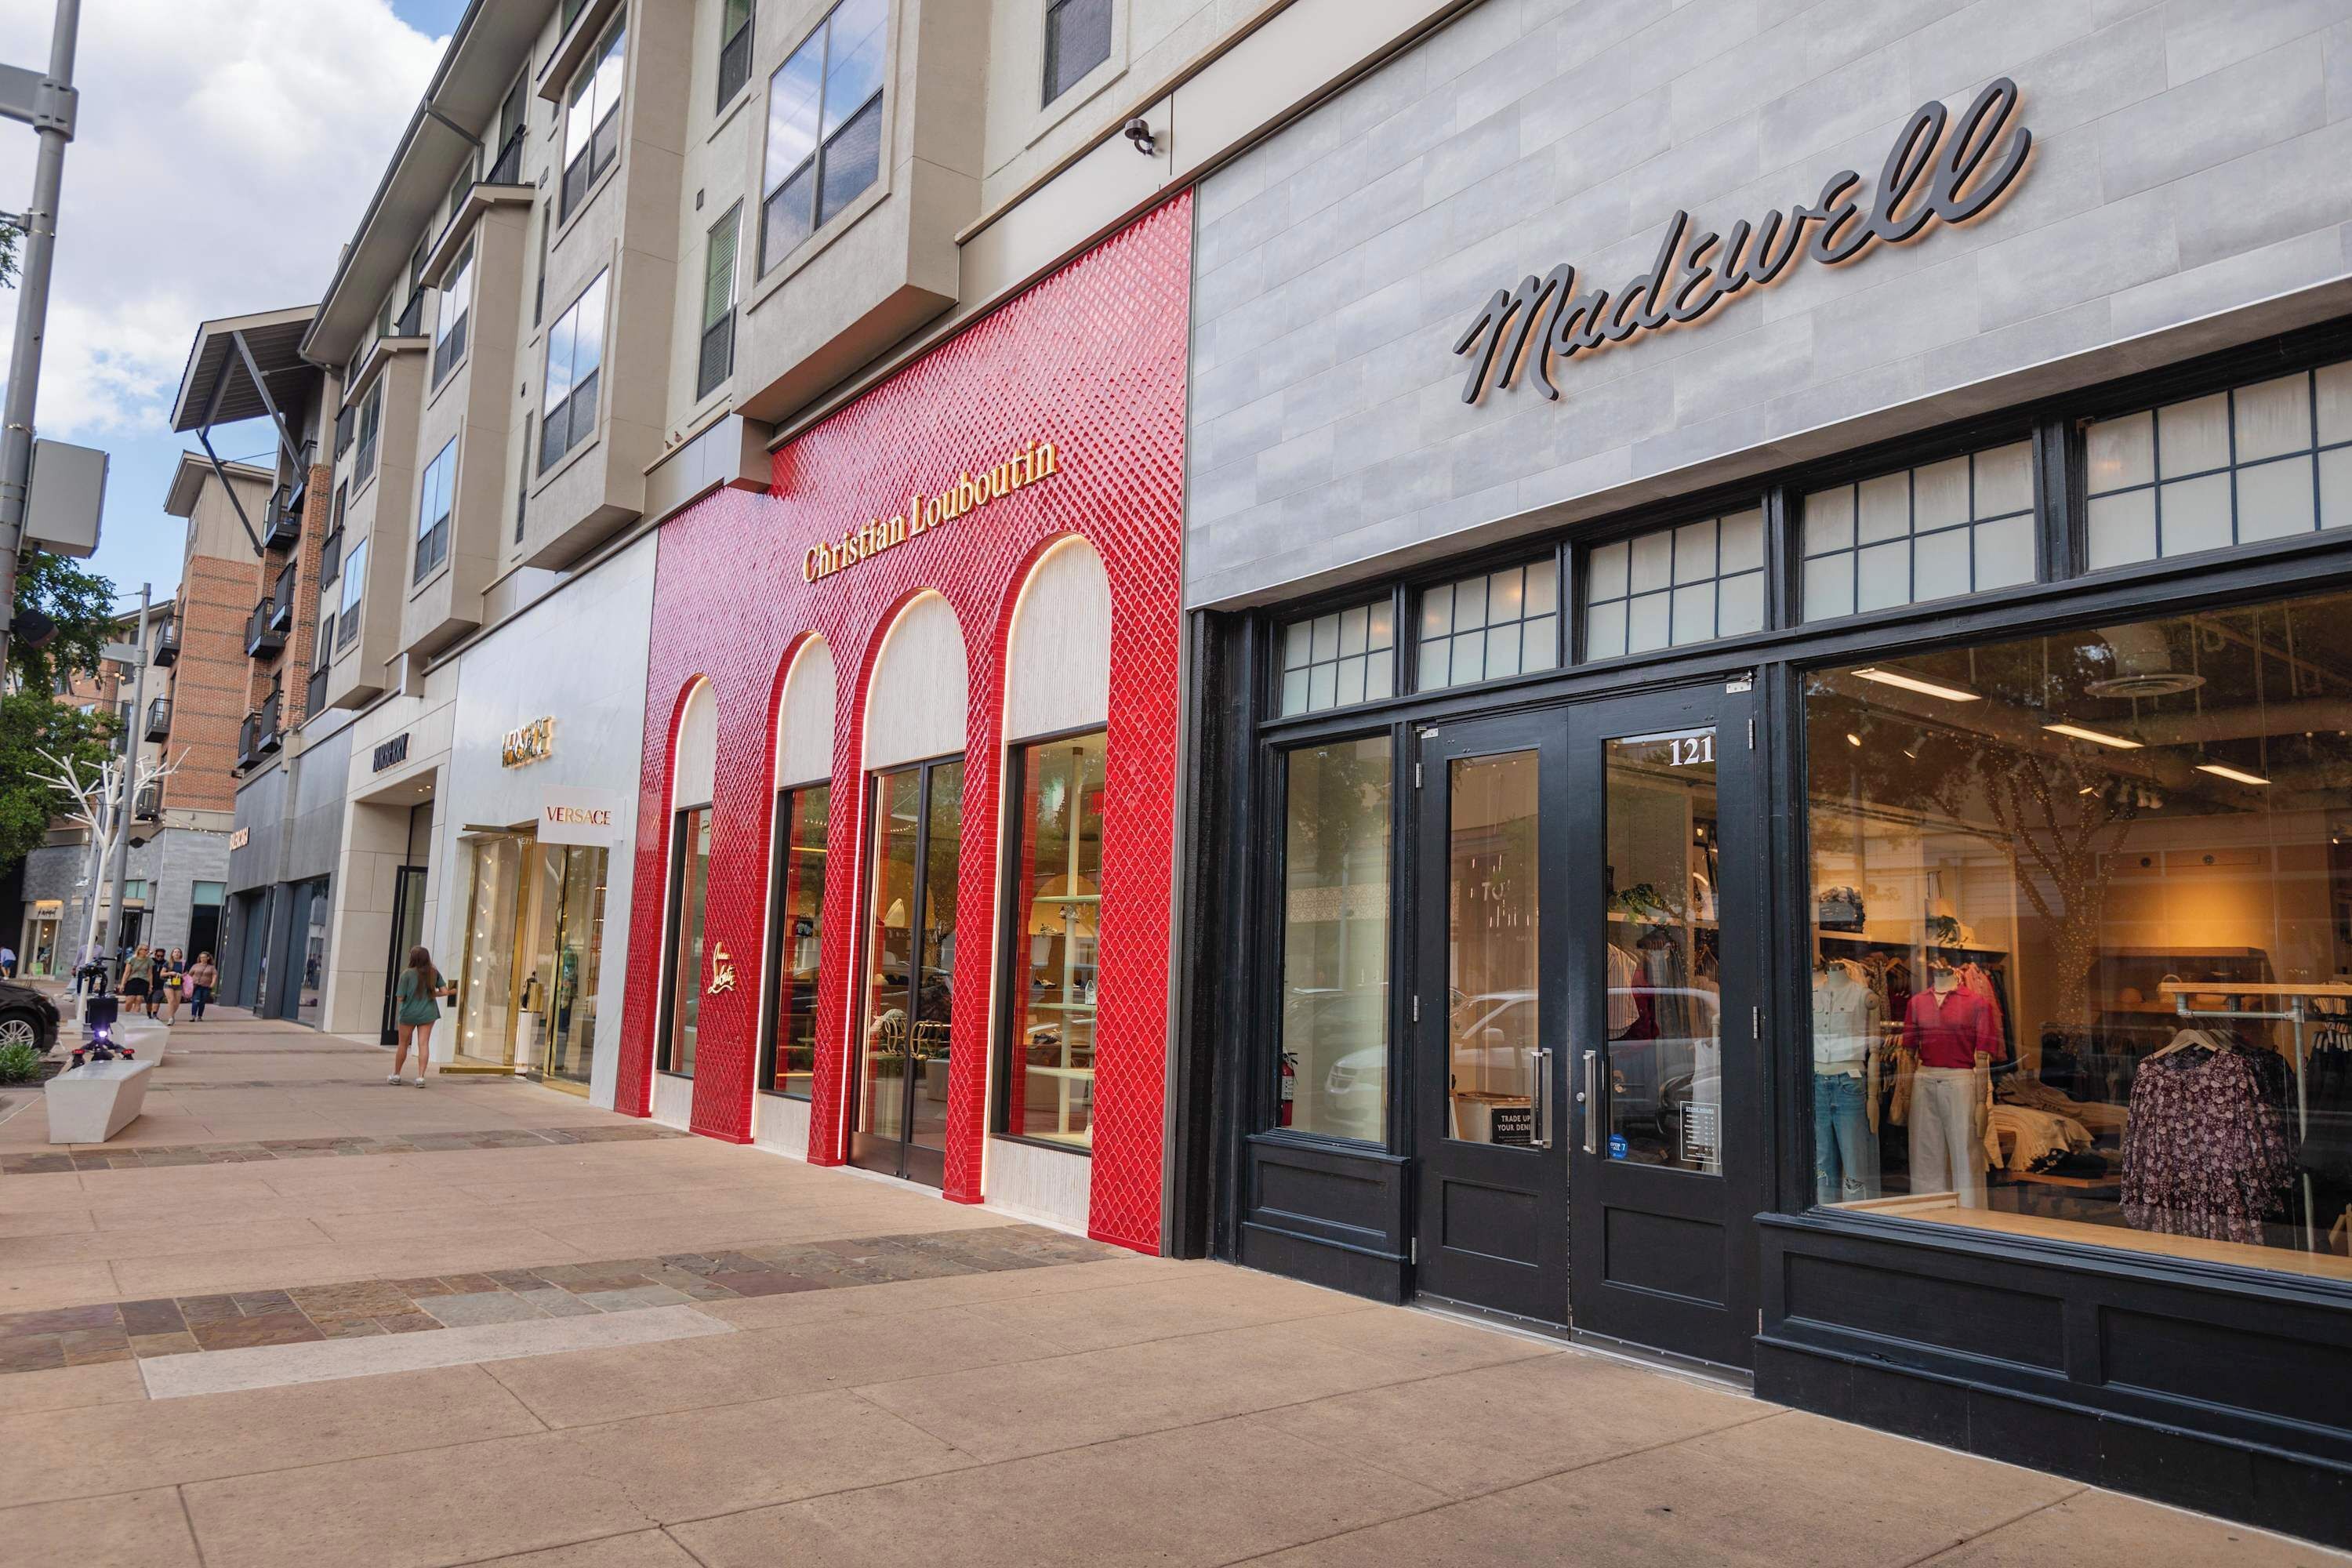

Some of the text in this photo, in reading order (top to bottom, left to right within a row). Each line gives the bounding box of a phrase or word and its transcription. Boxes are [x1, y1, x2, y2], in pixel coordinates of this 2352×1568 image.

[1454, 77, 2032, 404] Madewell
[803, 440, 1058, 583] Christian Louboutin
[1669, 735, 1715, 767] 121
[546, 806, 612, 826] VERSACE
